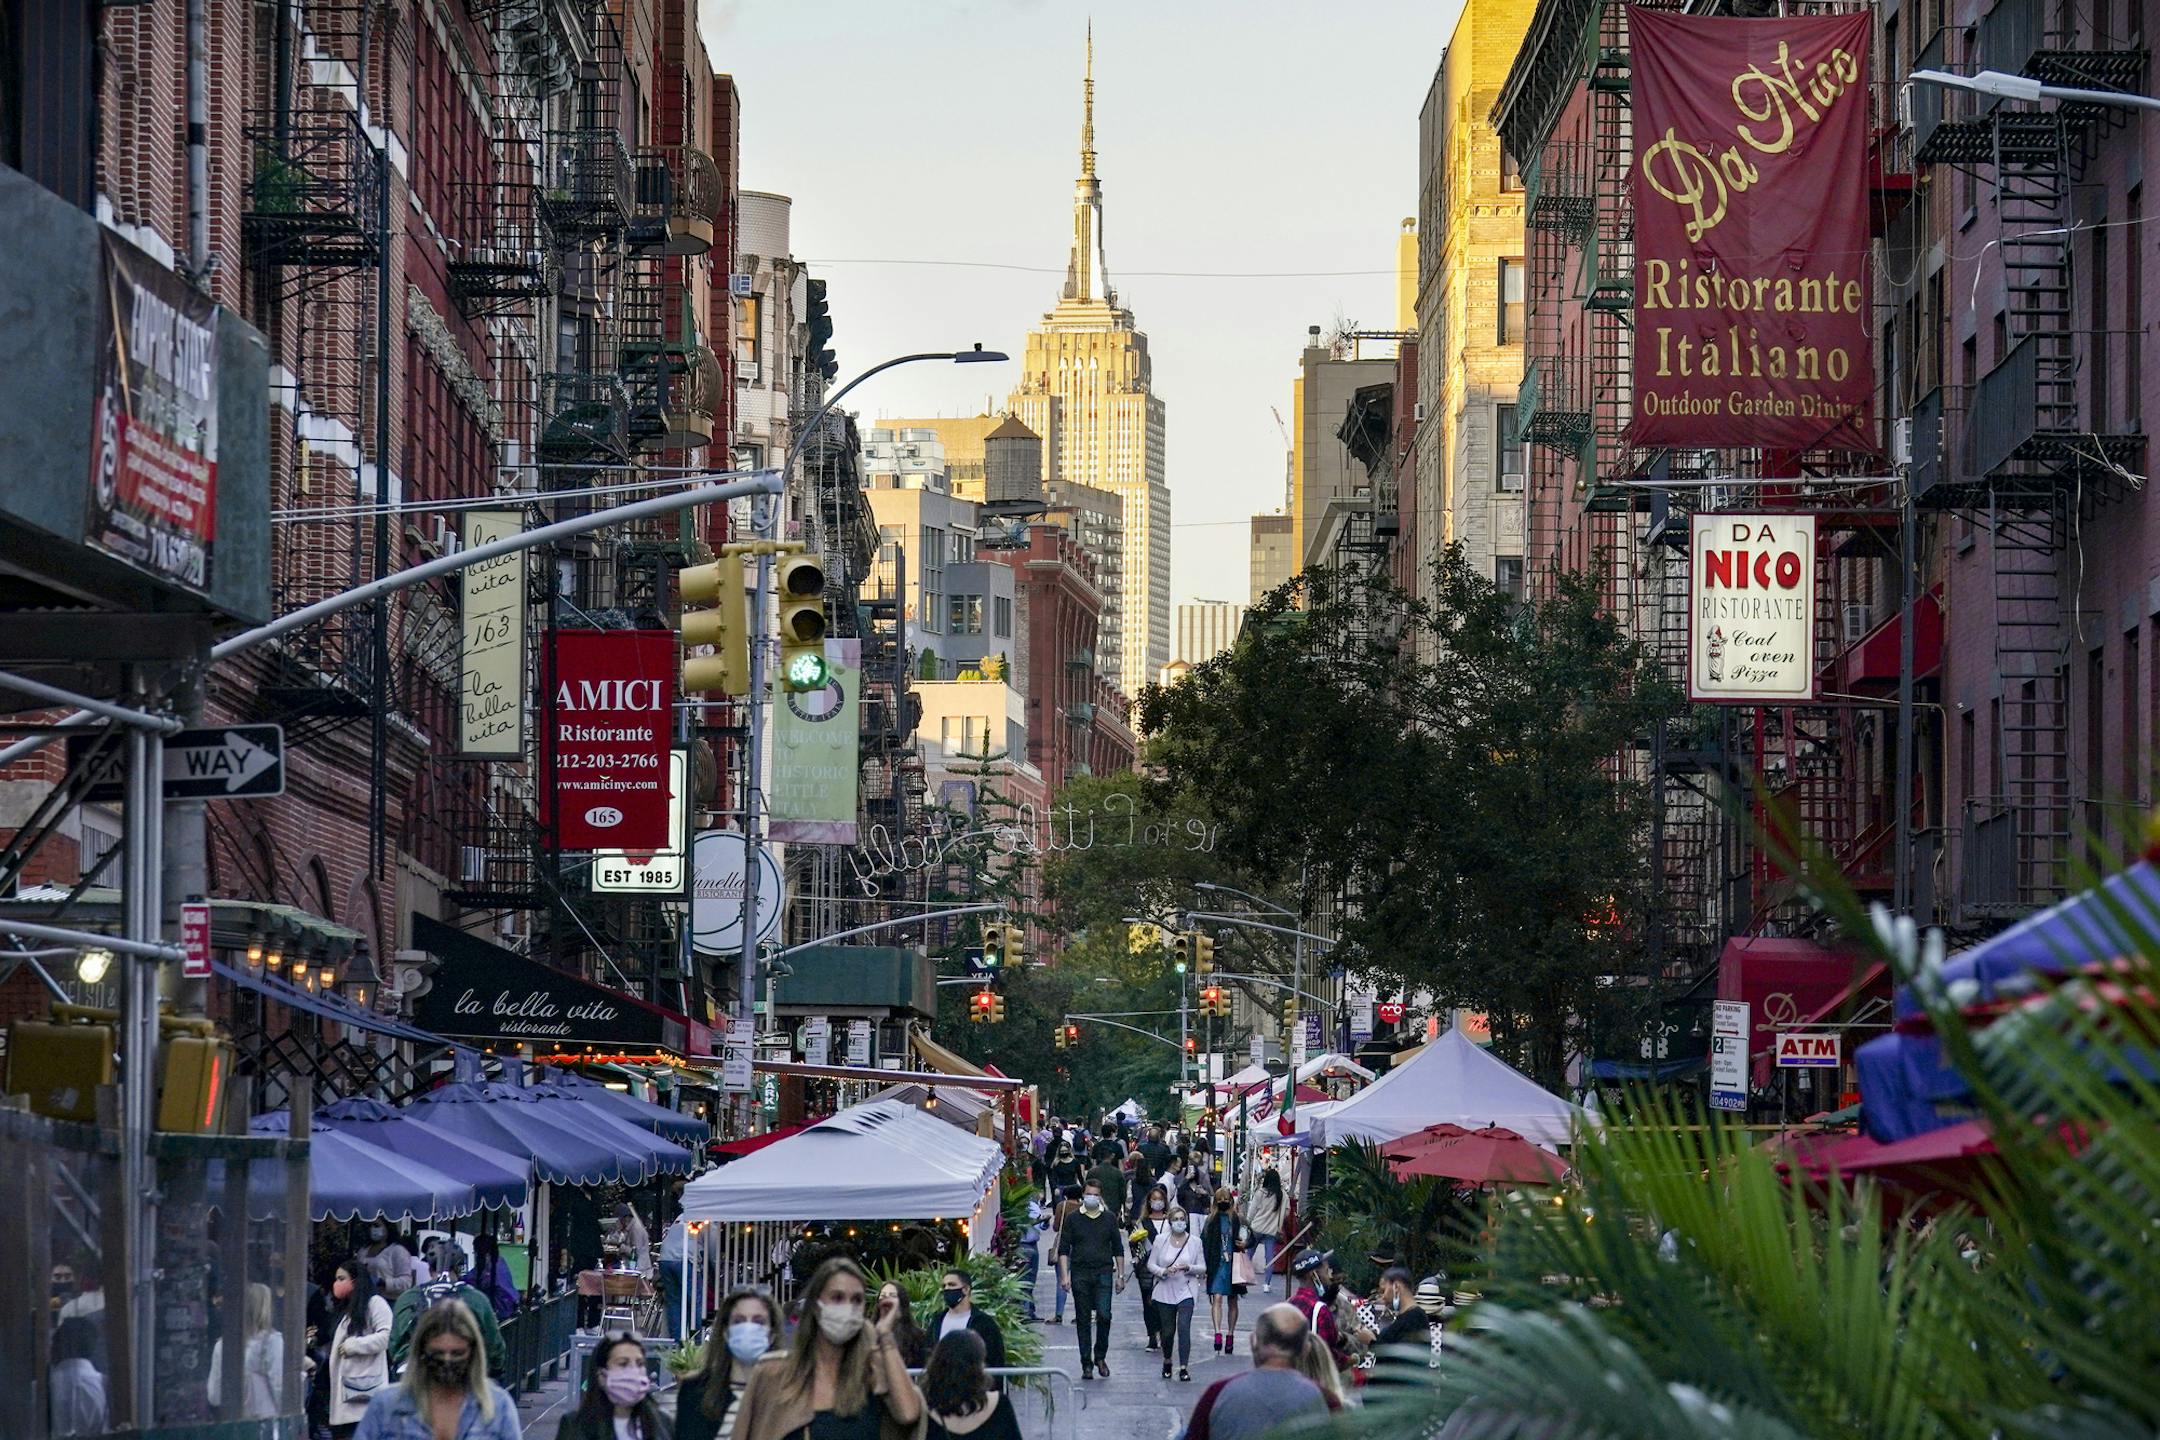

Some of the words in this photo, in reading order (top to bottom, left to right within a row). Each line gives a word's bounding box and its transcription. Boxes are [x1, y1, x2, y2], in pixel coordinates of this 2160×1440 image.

[1642, 126, 1758, 244] Da
[1731, 40, 1858, 154] Nico
[1643, 259, 1862, 313] Ristorante
[1656, 326, 1849, 382] Italiano
[1643, 391, 1721, 417] Outdoor
[1728, 391, 1795, 418] Garden
[1801, 394, 1864, 427] Dining
[1732, 523, 1776, 543] DA
[1705, 550, 1801, 591] NICO
[470, 572, 516, 595] vita
[1702, 597, 1803, 620] RISTORANTE
[473, 615, 510, 647] 163
[1732, 629, 1777, 648] Coal
[1750, 650, 1796, 663] oven
[471, 671, 503, 697] la
[1730, 665, 1779, 684] Pizza
[556, 680, 663, 711] AMICI
[466, 693, 517, 725] bella
[468, 717, 515, 744] vita
[560, 724, 653, 742] Ristorante
[775, 729, 853, 745] WELCOME
[185, 748, 252, 777] WAY
[775, 765, 848, 780] HISTORIC
[775, 783, 829, 798] LITTLE
[593, 811, 616, 824] 165
[776, 801, 816, 815] ITALY
[604, 871, 632, 883] EST
[639, 871, 673, 884] 1985
[697, 890, 745, 899] RISTORANT
[454, 988, 484, 1014] la
[492, 990, 559, 1018] bella
[567, 1000, 619, 1021] vita
[499, 1020, 572, 1036] ristorante
[726, 1048, 733, 1060] 2
[1715, 1038, 1722, 1052] 2
[1781, 1039, 1836, 1055] ATM
[765, 1072, 775, 1104] PARK
